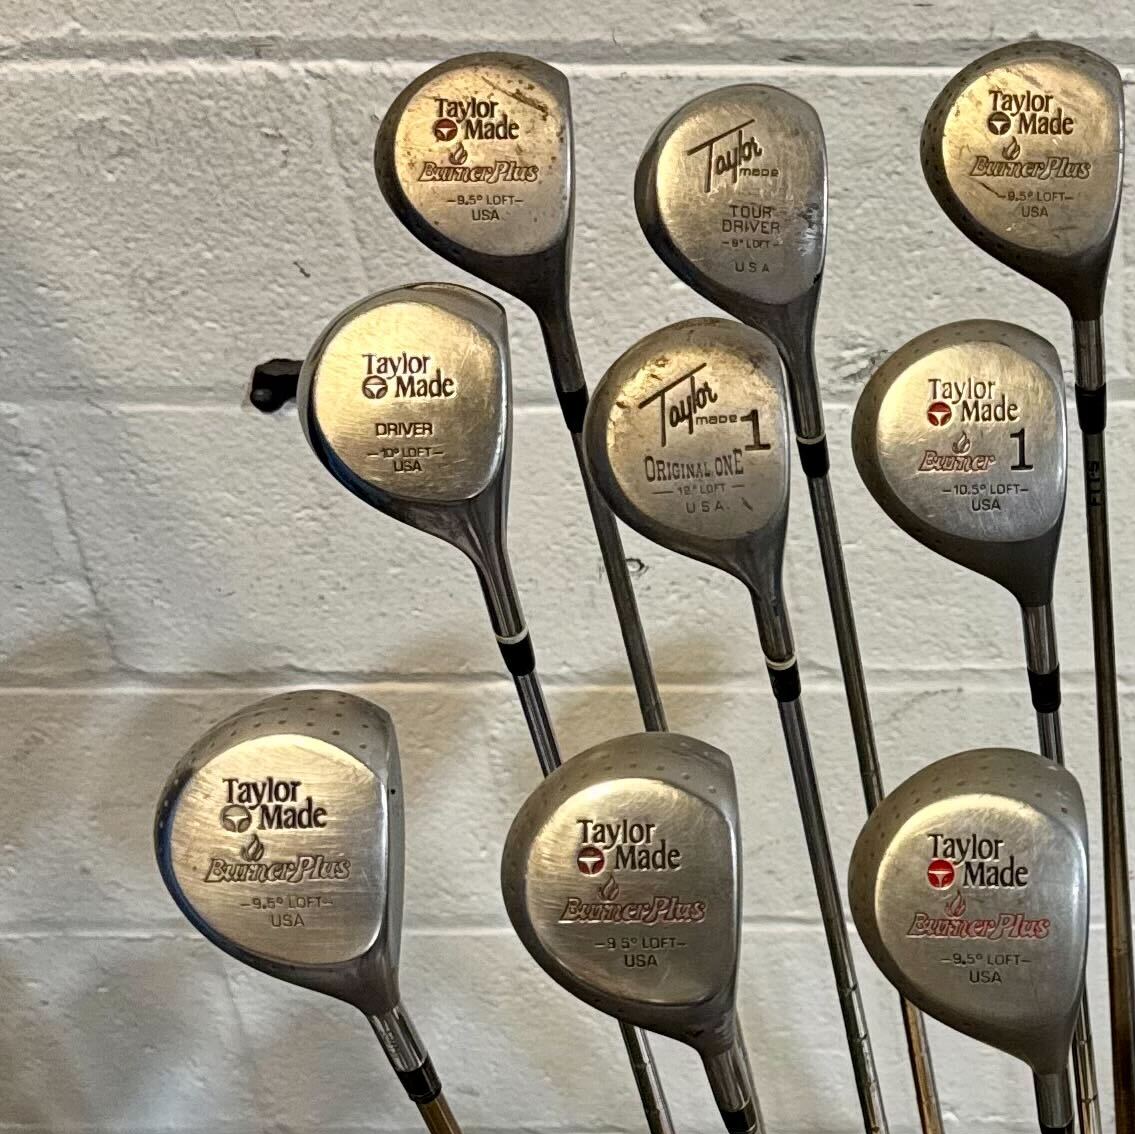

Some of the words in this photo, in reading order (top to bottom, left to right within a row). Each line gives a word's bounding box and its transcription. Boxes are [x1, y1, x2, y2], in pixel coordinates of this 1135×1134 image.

[434, 97, 499, 124] Taylor
[989, 90, 1054, 117] Taylor
[464, 113, 519, 140] Made
[1018, 108, 1073, 135] Made
[686, 119, 763, 193] Taylor
[472, 210, 500, 221] USA
[729, 205, 775, 218] TOUR
[1022, 207, 1048, 217] USA
[722, 220, 780, 234] DRIVER
[362, 351, 431, 379] Taylor
[395, 368, 455, 398] Made
[928, 377, 996, 404] Taylor
[638, 362, 718, 447] Taylor
[961, 394, 1019, 422] Made
[375, 422, 433, 436] DRIVER
[740, 409, 771, 451] 1
[918, 450, 997, 472] Burner
[1010, 428, 1033, 471] 1
[393, 460, 423, 473] USA
[700, 483, 726, 494] LOFT
[971, 499, 1001, 511] USA
[222, 777, 302, 810] Taylor
[257, 796, 328, 830] Made
[576, 819, 655, 850] Taylor
[614, 839, 681, 870] Made
[928, 834, 1004, 866] Taylor
[963, 856, 1028, 888] Made
[271, 914, 305, 927] USA
[624, 955, 658, 967] USA
[969, 970, 1002, 983] USA
